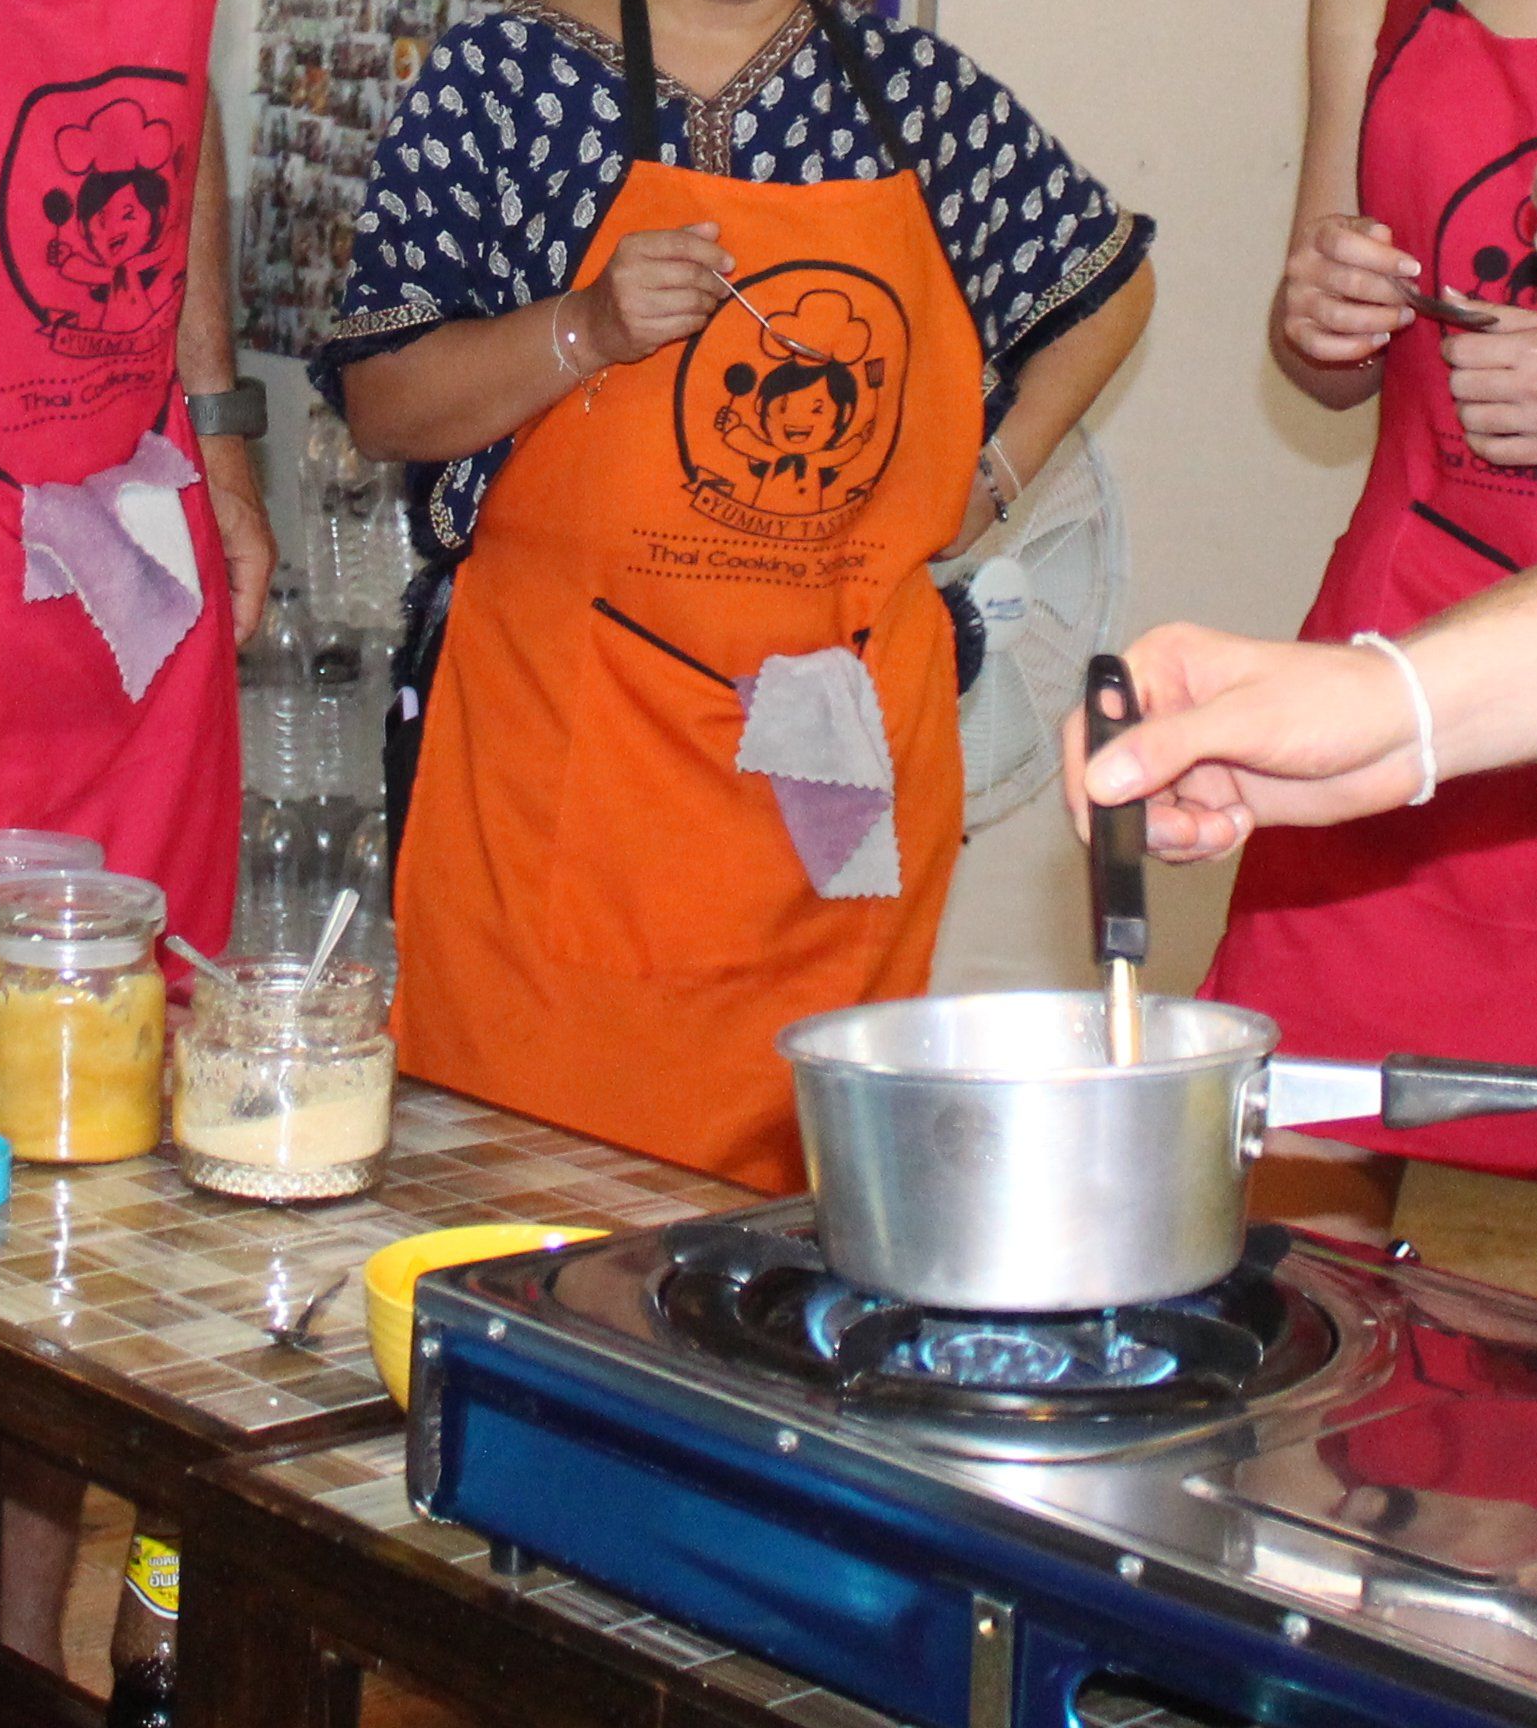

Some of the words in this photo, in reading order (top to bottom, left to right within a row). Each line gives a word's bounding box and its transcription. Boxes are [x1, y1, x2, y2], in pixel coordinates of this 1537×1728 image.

[707, 498, 790, 537] YUMMY
[647, 543, 700, 566] Thai
[708, 549, 807, 578] Cooking
